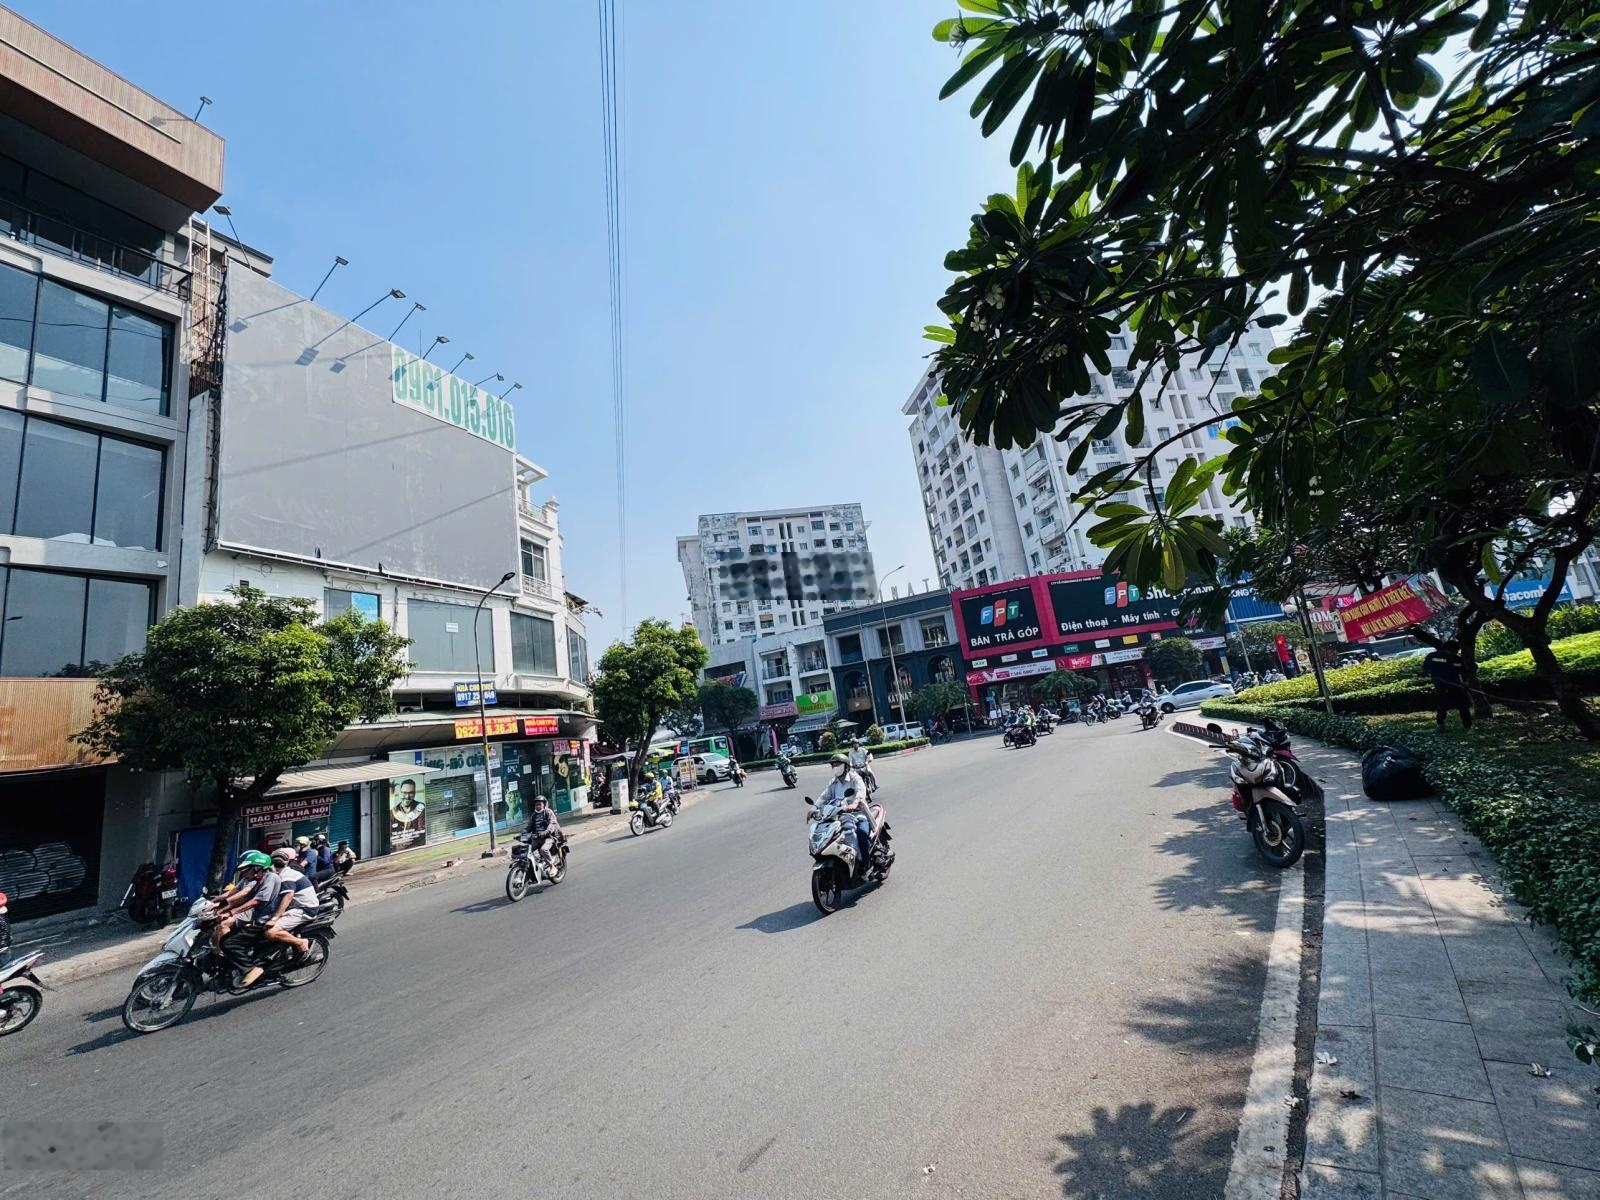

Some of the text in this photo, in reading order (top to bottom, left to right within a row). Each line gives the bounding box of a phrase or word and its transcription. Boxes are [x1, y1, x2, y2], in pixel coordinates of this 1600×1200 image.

[1105, 585, 1140, 604] FPT
[981, 602, 1020, 624] FPT
[1061, 619, 1083, 632] Điện
[1085, 616, 1109, 631] thoại
[1121, 613, 1140, 626] Máy
[1142, 610, 1160, 621] tính
[970, 635, 991, 647] BÁN
[1017, 626, 1039, 639] GÓP
[888, 692, 913, 703] KATNAT
[246, 805, 274, 815] NEM
[277, 801, 308, 810] CHUA
[312, 806, 329, 814] NỘI
